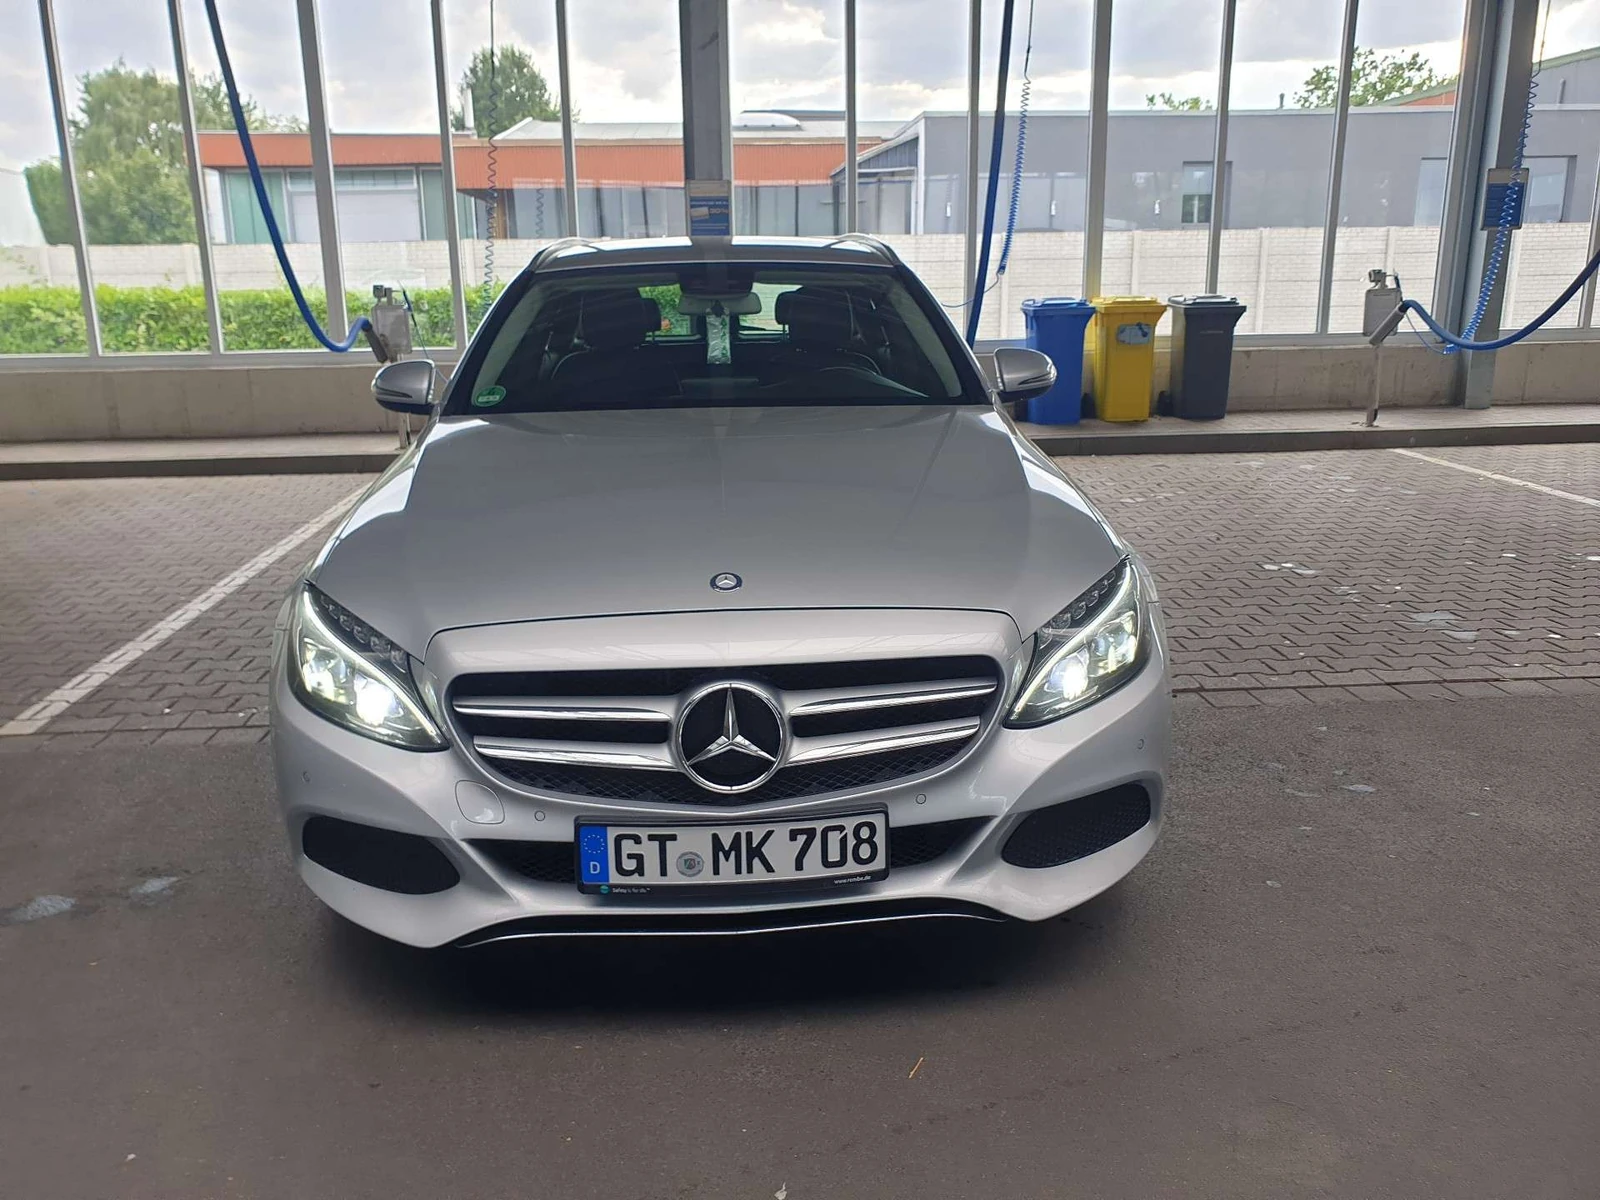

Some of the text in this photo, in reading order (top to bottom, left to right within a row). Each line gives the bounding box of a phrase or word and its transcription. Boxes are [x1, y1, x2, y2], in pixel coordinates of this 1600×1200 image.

[614, 821, 878, 877] GT MK 708
[590, 861, 600, 874] D
